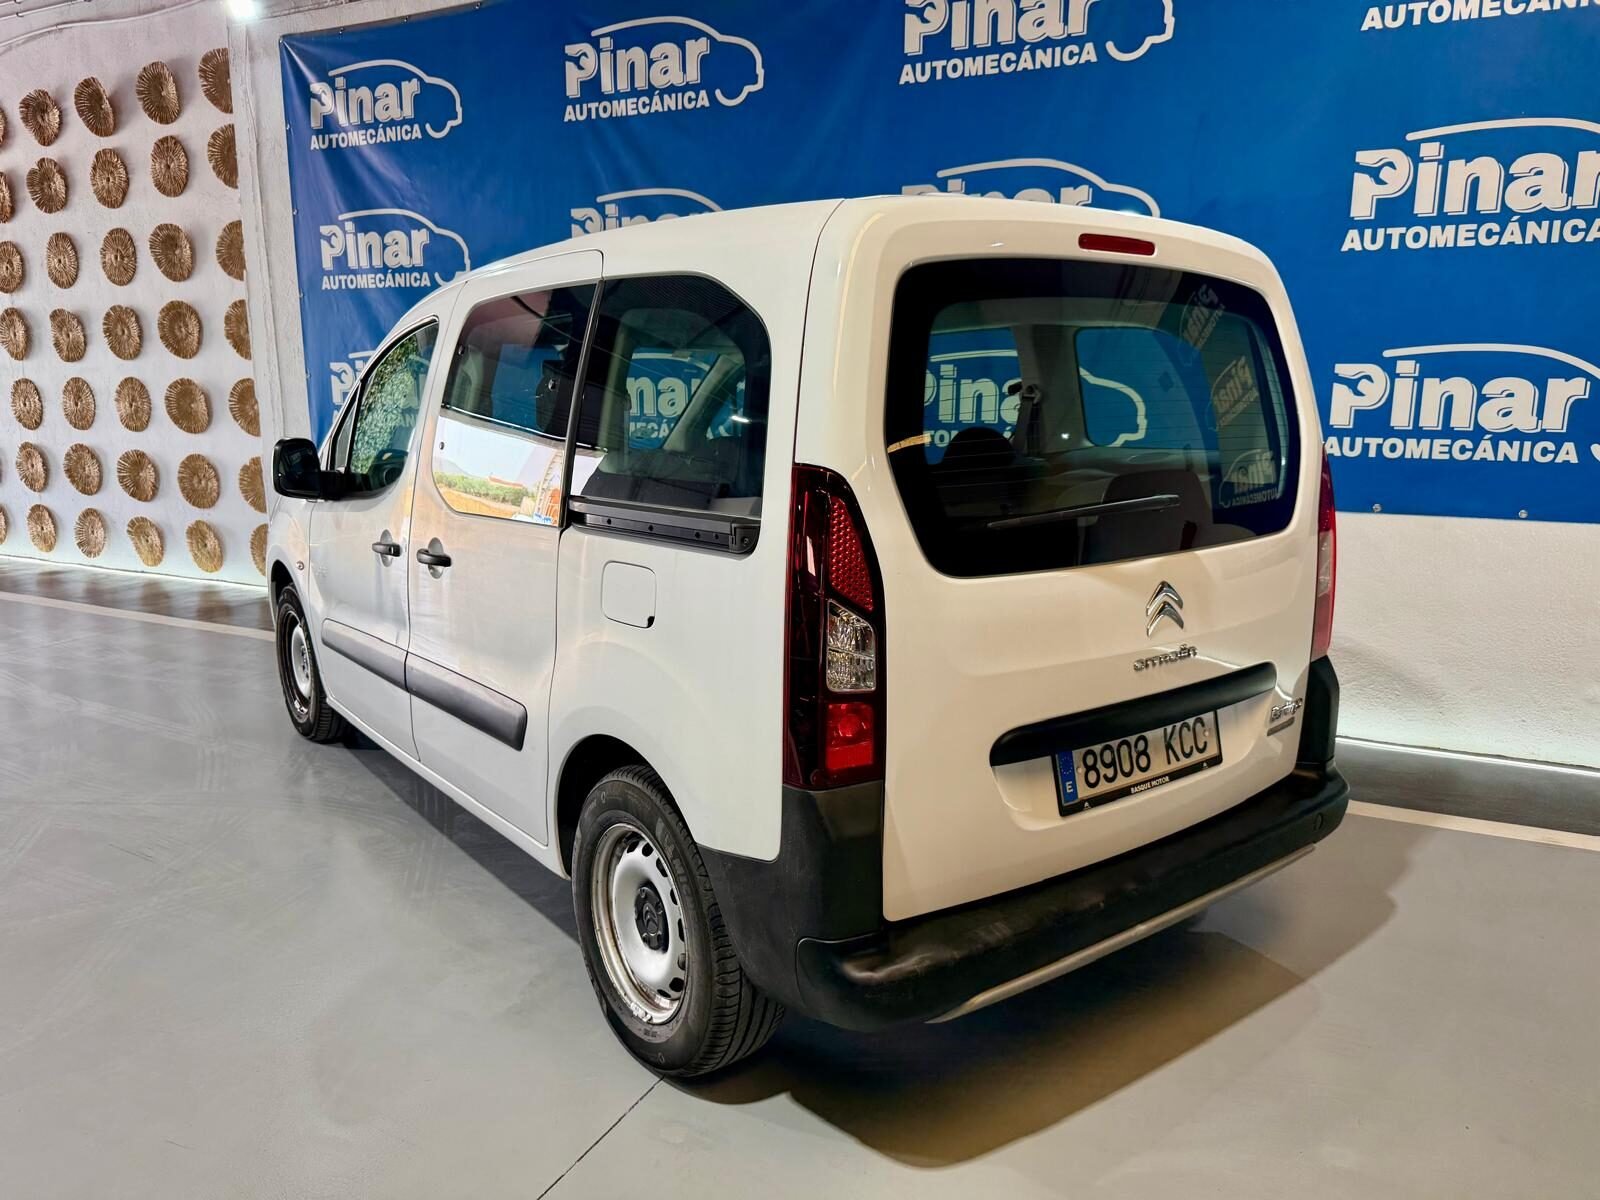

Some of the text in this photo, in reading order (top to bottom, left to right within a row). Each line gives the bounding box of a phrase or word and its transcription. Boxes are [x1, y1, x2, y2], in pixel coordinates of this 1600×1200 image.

[564, 37, 710, 98] Pinar
[899, 44, 1098, 85] AUTOMECÁNICA
[310, 76, 421, 129] Pinar
[563, 90, 711, 122] AUTOMECÁNICA
[310, 123, 422, 150] AUTOMECÁNICA
[319, 221, 430, 271] Pinar
[322, 270, 431, 290] AUTOMECÁNICA
[1329, 360, 1591, 433] Pinar
[1323, 434, 1579, 464] AUTOMECÁNICA
[1082, 717, 1208, 788] 8908 KCC
[1065, 781, 1074, 793] E
